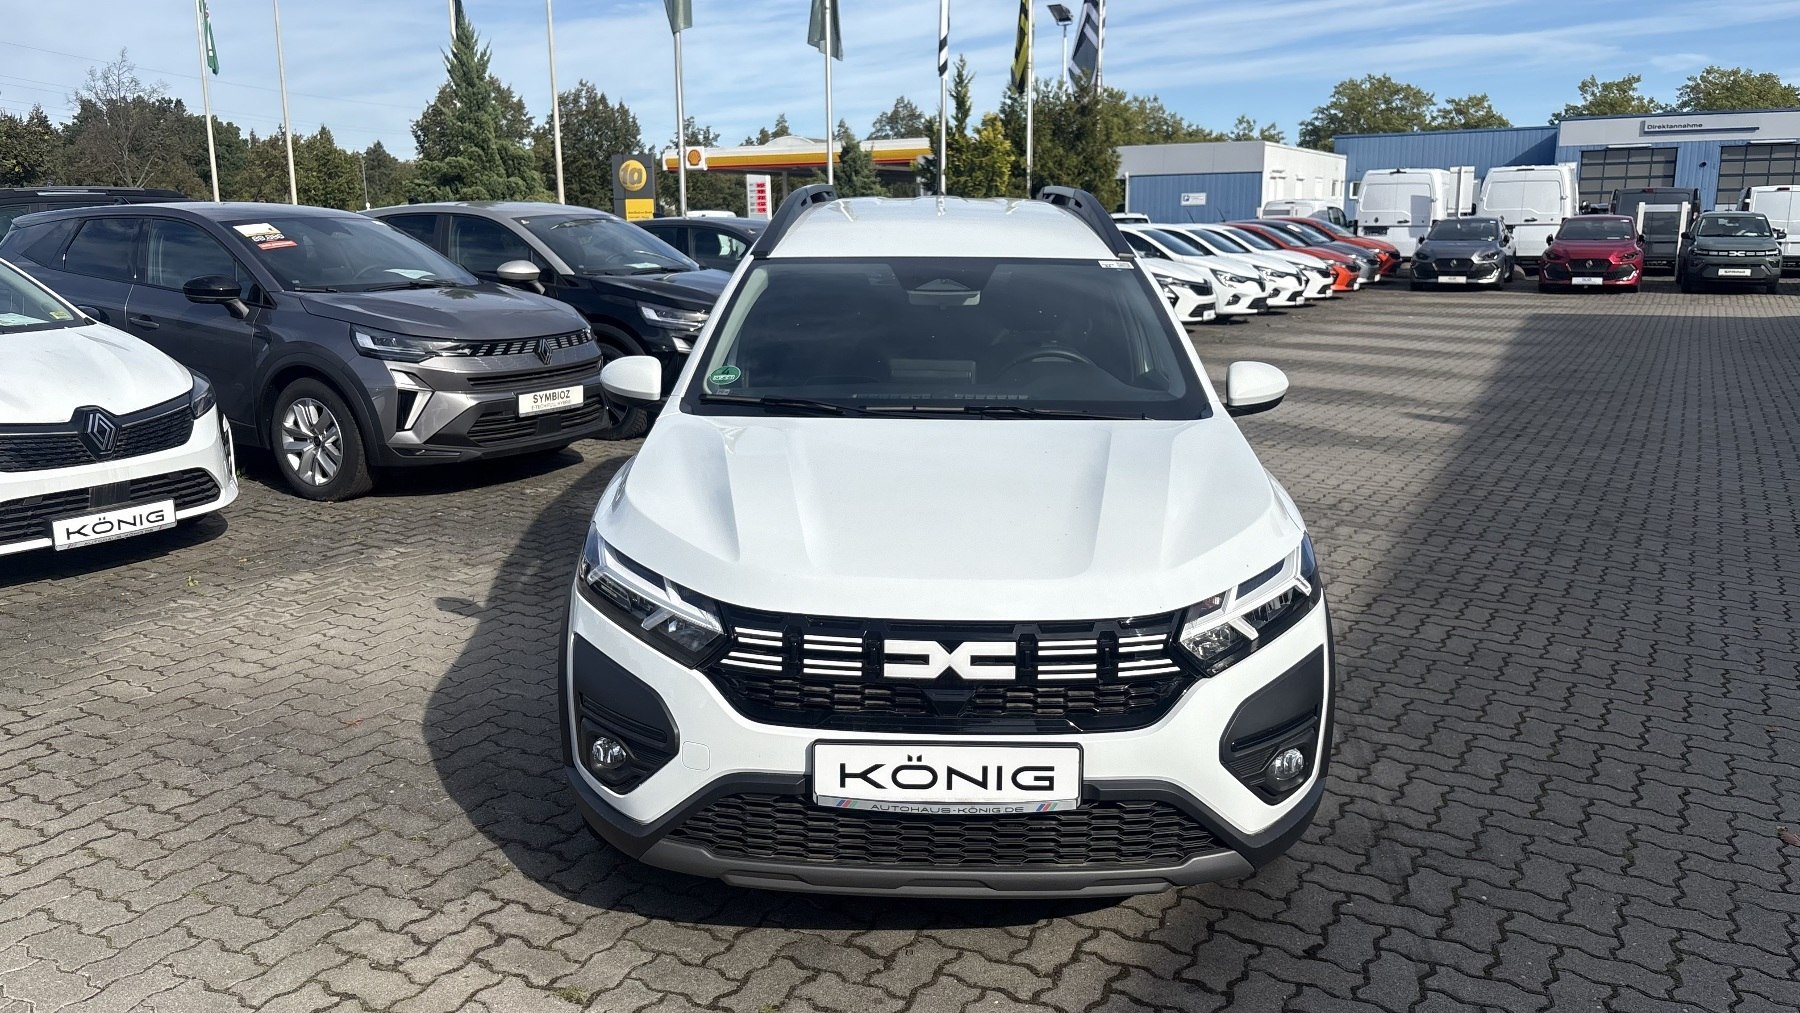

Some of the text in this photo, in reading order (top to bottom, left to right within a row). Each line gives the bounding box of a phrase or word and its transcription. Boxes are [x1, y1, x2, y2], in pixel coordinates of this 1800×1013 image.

[532, 390, 571, 403] SYMBIOZ
[66, 509, 165, 541] KÖNIG
[839, 754, 1055, 792] KÖNIG
[870, 803, 1025, 814] AUTOHAUS-KÖNIG.DE
